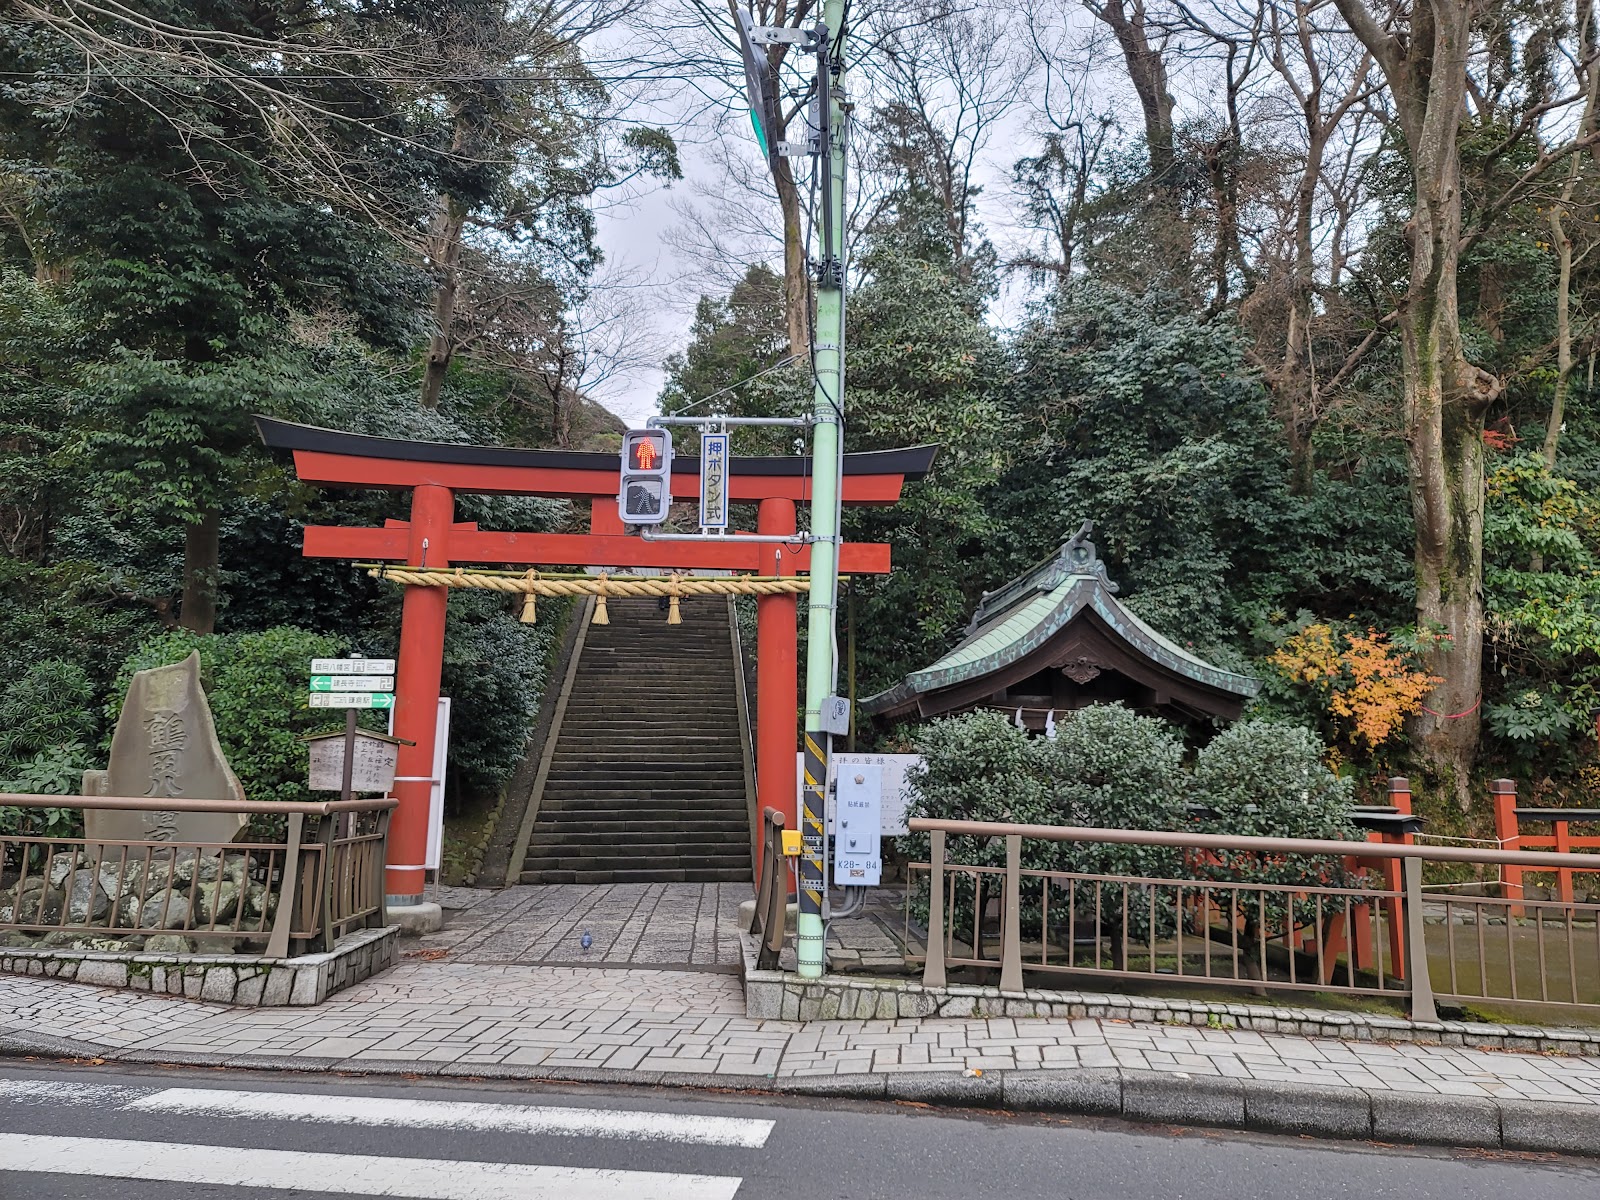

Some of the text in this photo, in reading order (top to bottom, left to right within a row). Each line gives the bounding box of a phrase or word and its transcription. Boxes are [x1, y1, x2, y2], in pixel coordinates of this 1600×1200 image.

[707, 442, 722, 520] 押ボタン式
[333, 679, 355, 687] 建長寺
[832, 756, 898, 765] 拝の皆様へ
[865, 860, 877, 870] 84
